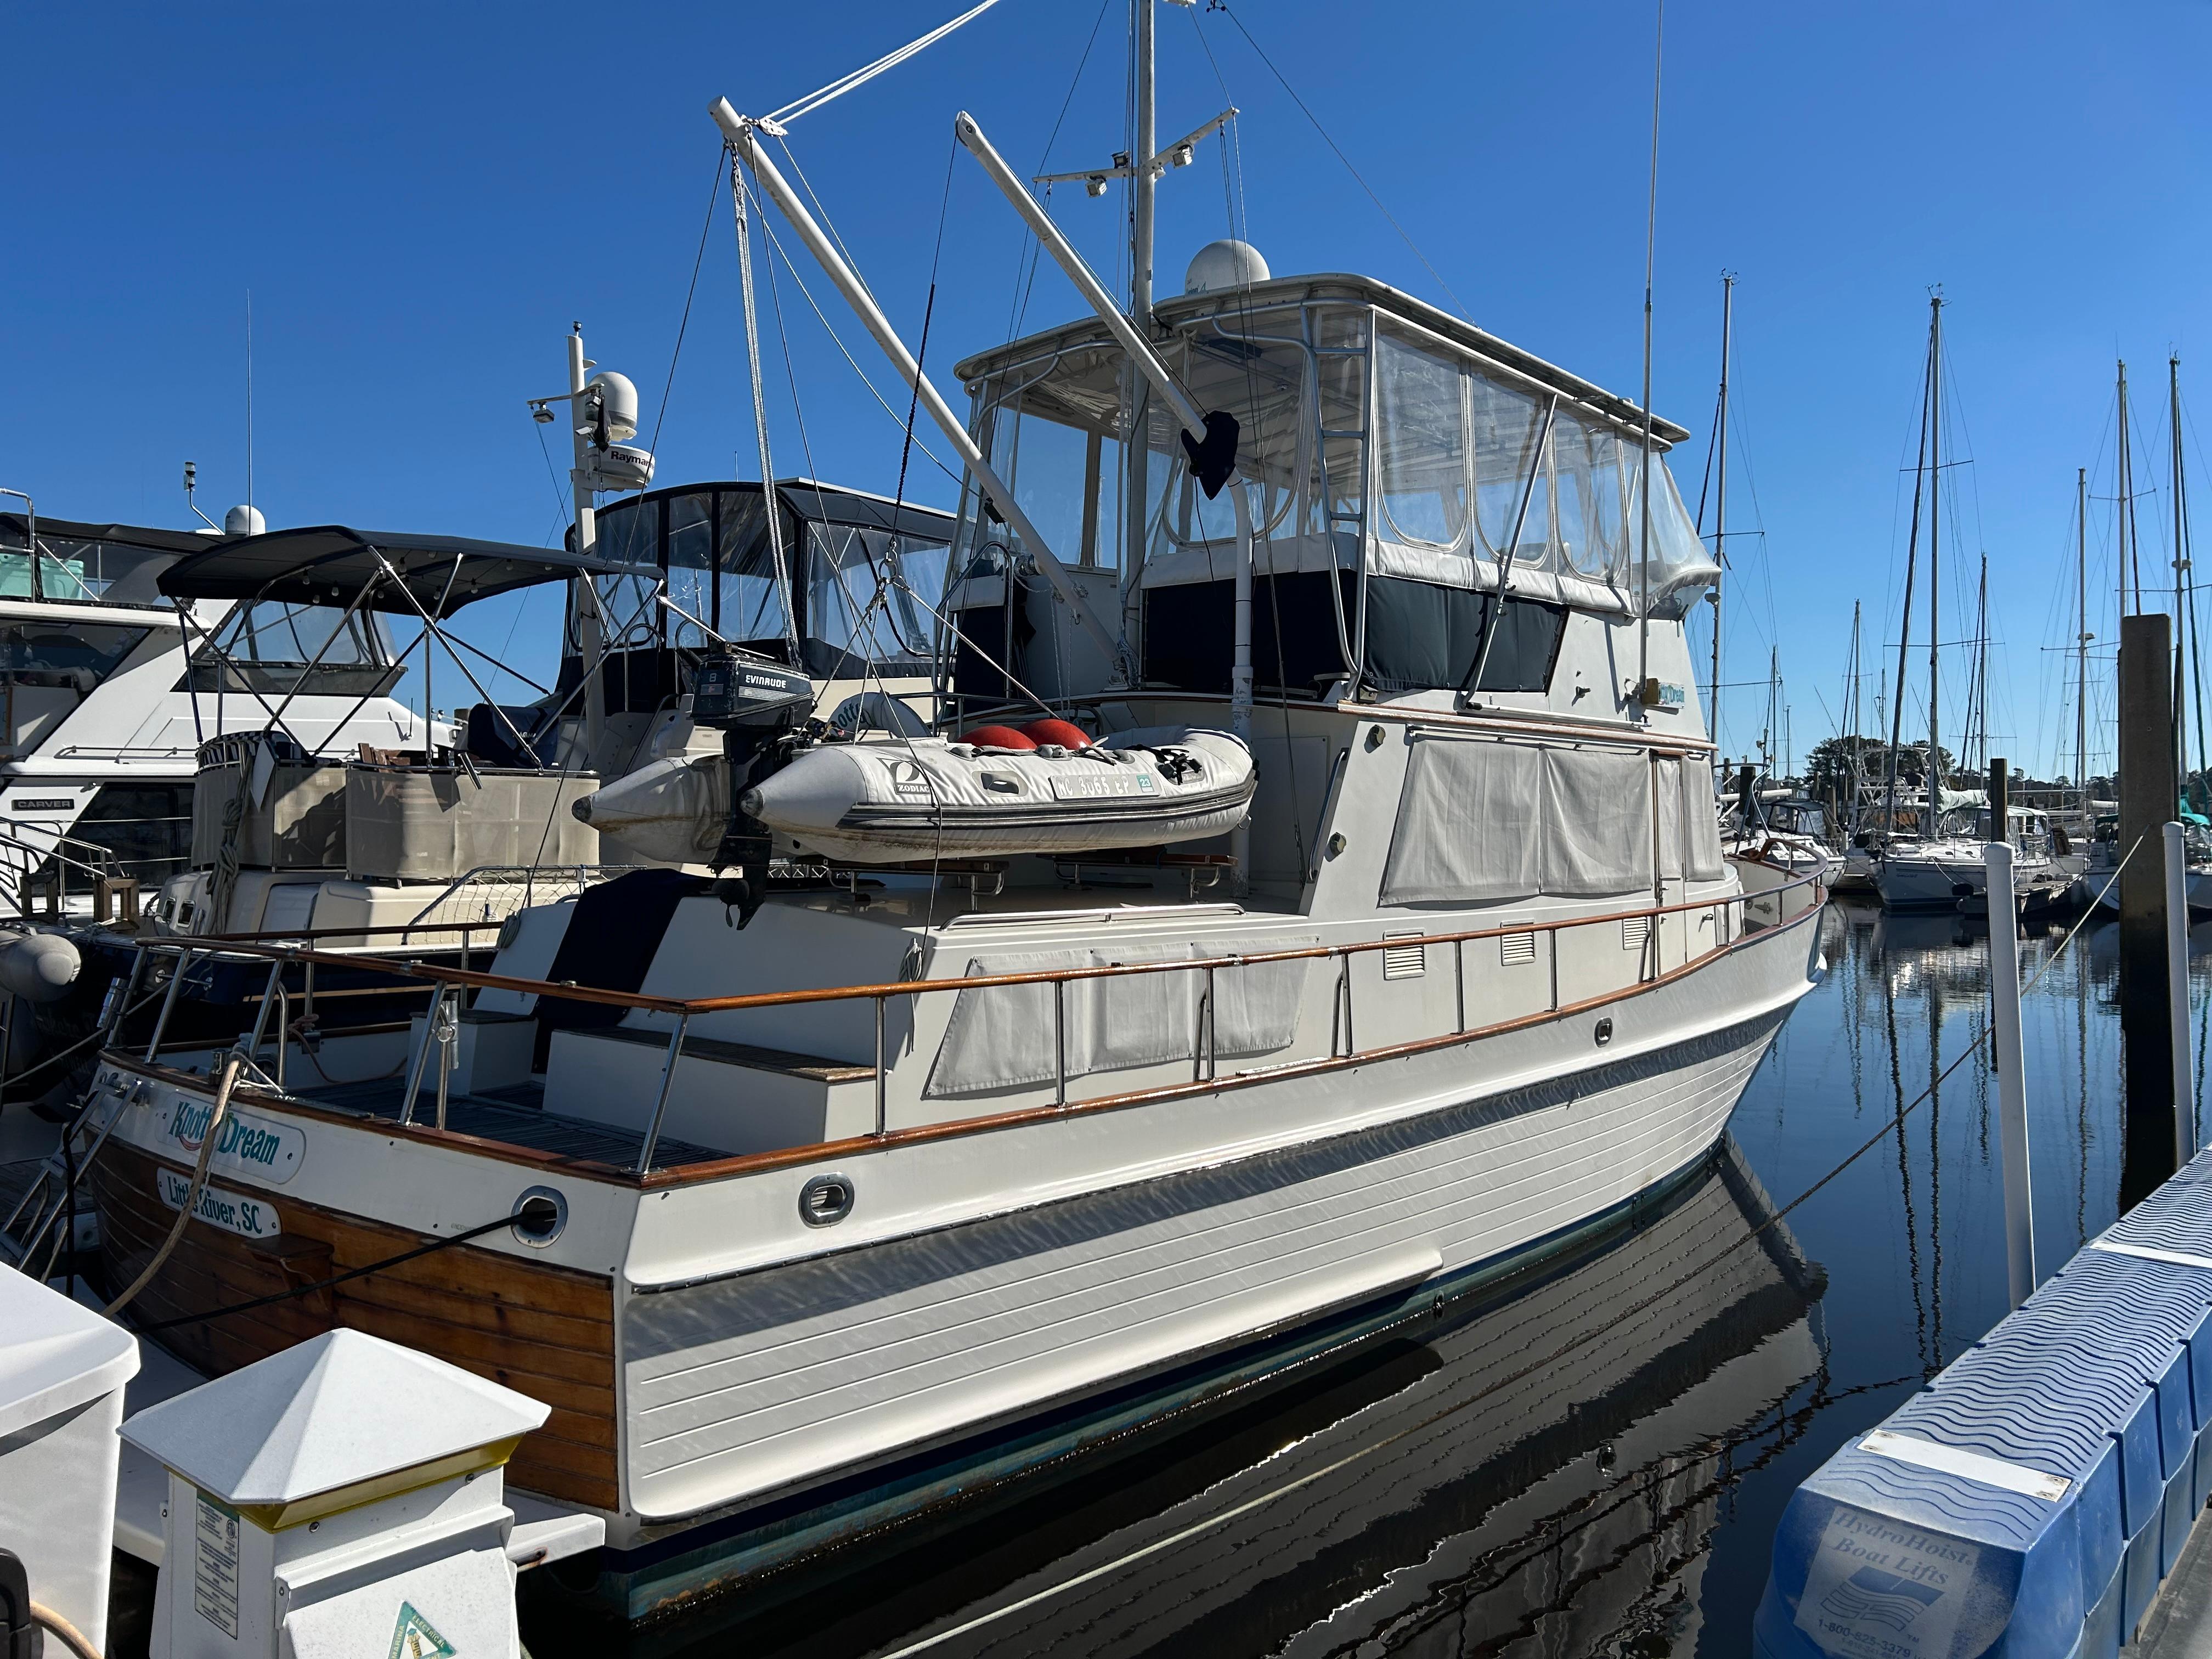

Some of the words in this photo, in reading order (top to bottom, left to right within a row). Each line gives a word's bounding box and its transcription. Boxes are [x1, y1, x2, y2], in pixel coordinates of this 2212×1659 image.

[611, 450, 654, 470] Raymarne
[709, 673, 717, 682] 8
[746, 674, 787, 688] EVINRUDE
[1139, 778, 1151, 787] 23
[168, 1101, 216, 1141] Knott
[217, 1117, 280, 1165] Dream
[241, 1201, 262, 1234] SC
[1833, 1537, 1889, 1564] Boat
[1894, 1556, 1949, 1584] Lifts
[412, 1615, 445, 1648] ELECTRICAL
[1819, 1618, 1911, 1657] 1-800-825-3379
